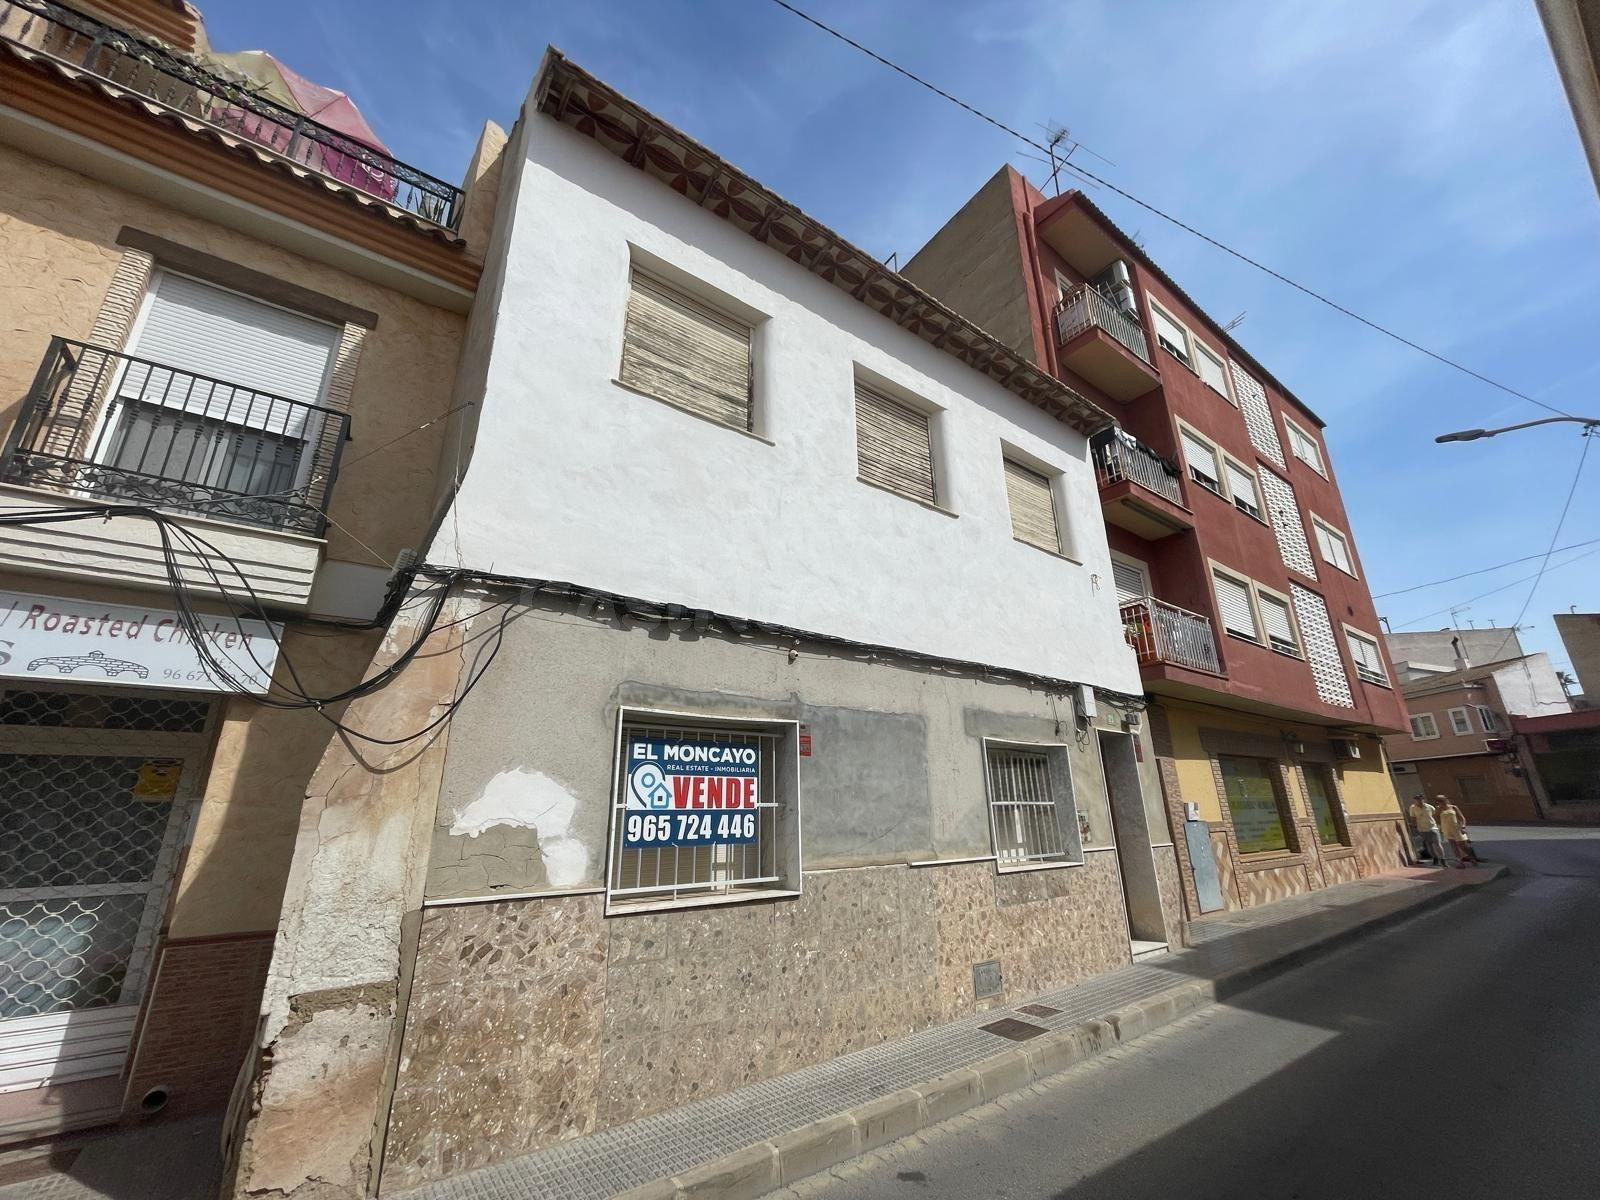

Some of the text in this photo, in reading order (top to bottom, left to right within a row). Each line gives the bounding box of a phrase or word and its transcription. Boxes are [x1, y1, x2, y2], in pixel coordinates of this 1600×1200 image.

[20, 604, 148, 640] Roasted
[163, 668, 181, 680] 96
[633, 743, 756, 764] EL MONCAYO
[673, 776, 755, 809] VENDE
[627, 814, 755, 842] 965 724 446
